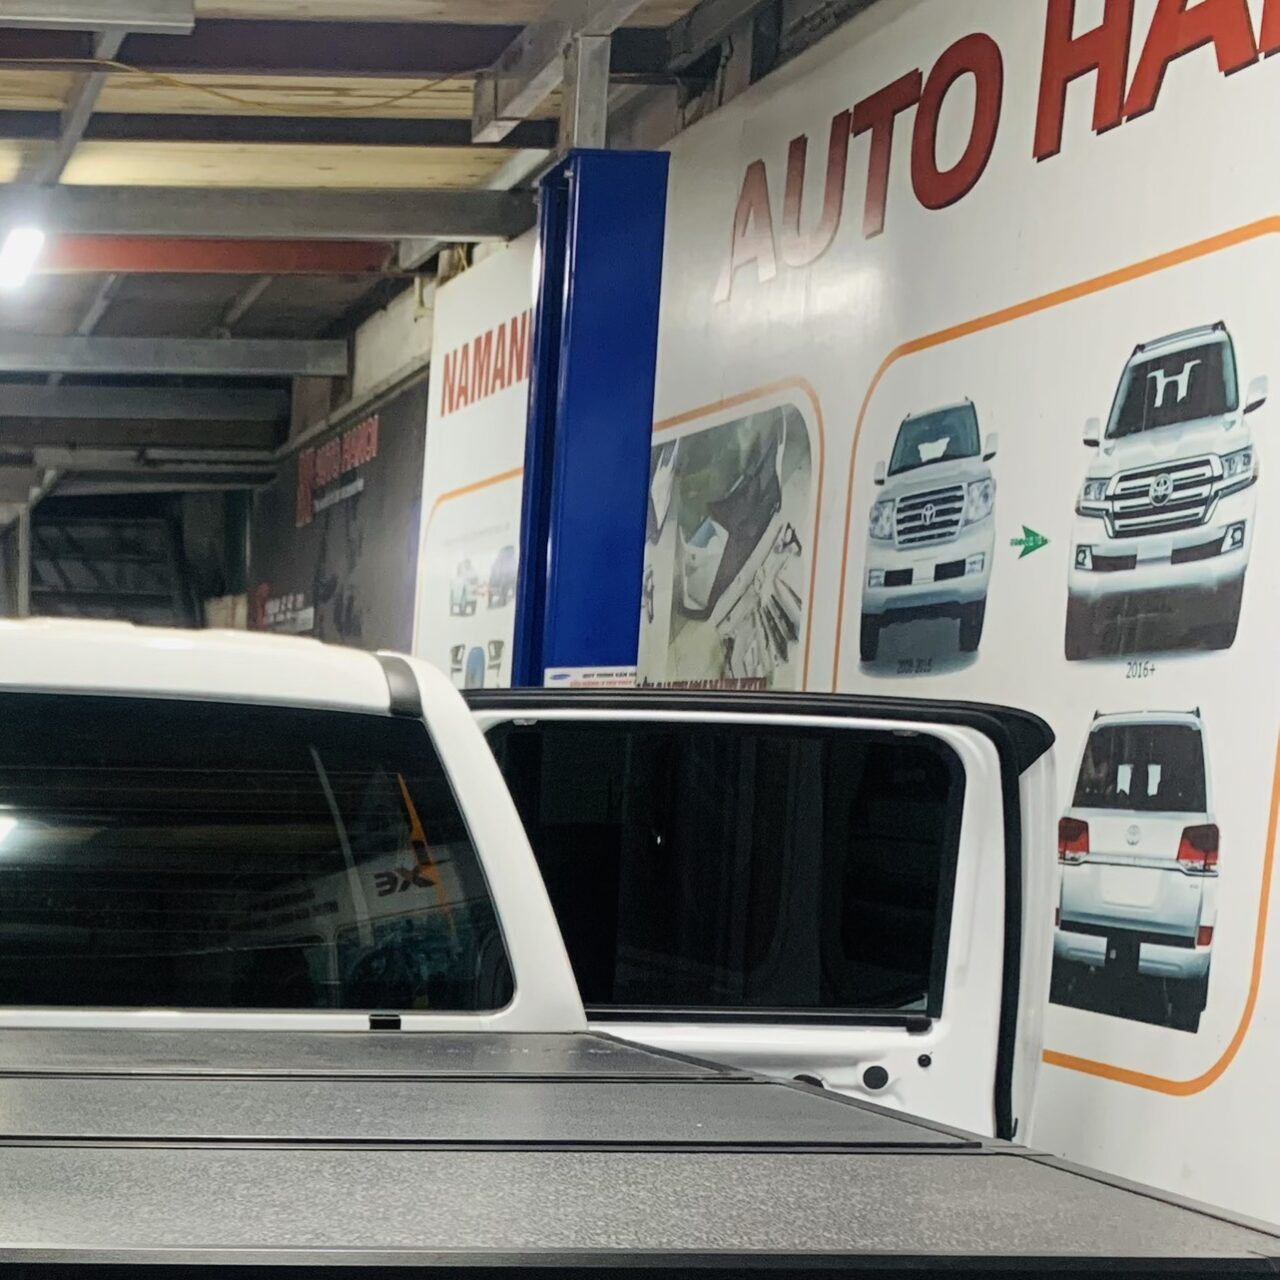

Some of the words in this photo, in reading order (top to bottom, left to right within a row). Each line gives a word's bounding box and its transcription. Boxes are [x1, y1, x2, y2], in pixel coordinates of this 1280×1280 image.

[713, 33, 1004, 303] AUTO
[1032, 0, 1280, 163] HA
[440, 308, 532, 418] NAMAN
[1125, 661, 1156, 679] 2016+
